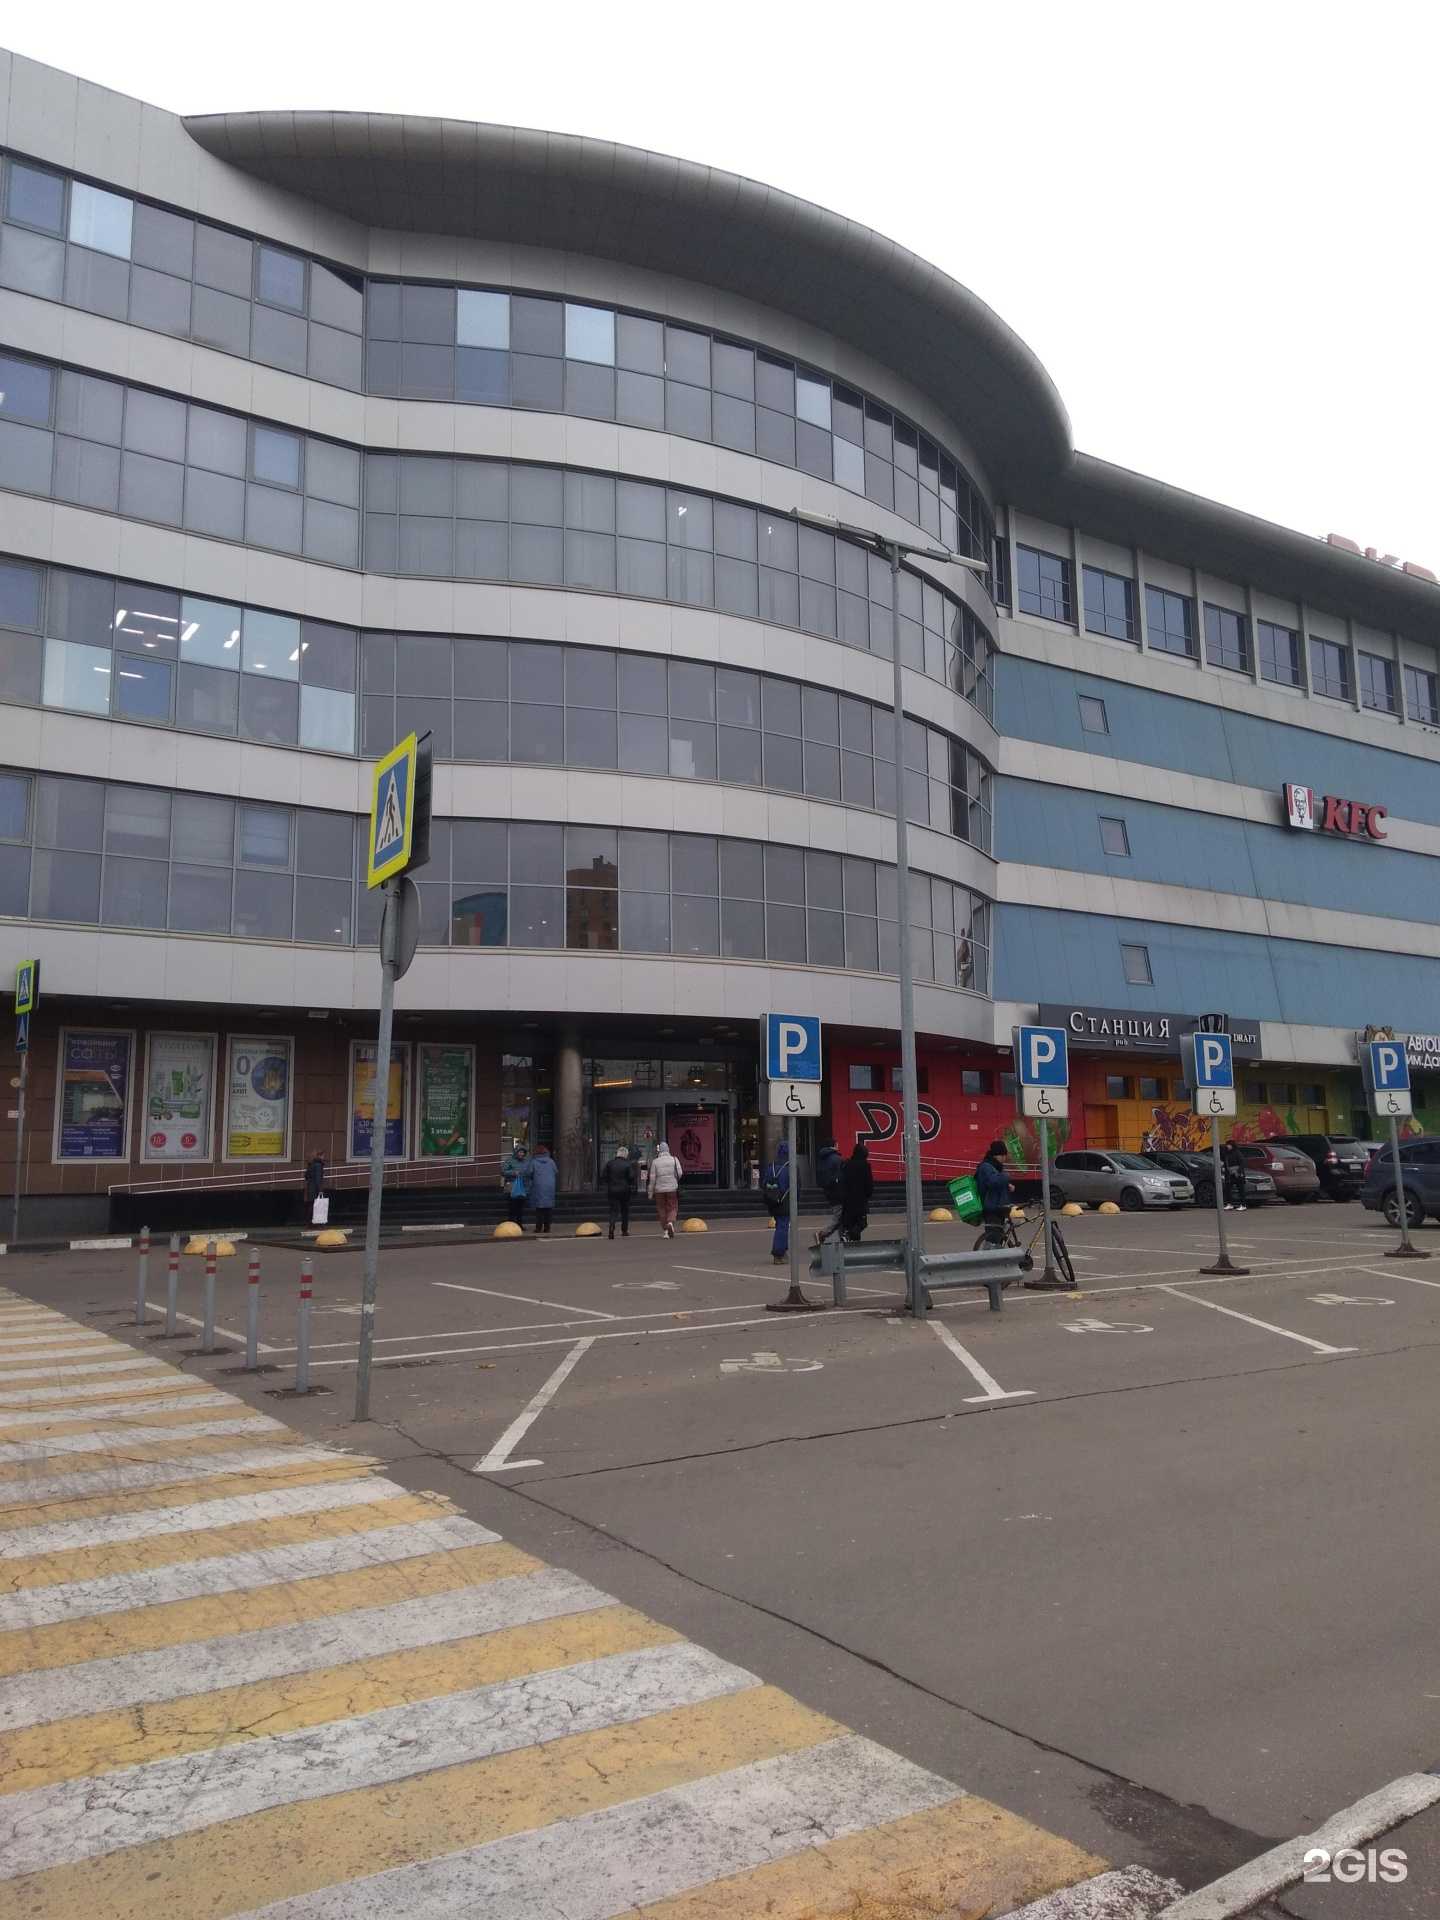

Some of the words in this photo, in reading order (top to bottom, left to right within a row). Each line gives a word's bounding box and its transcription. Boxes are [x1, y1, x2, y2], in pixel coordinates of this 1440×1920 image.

[1323, 796, 1387, 839] KFC
[780, 1022, 807, 1073] P
[1031, 1034, 1056, 1078] P
[1233, 1033, 1257, 1043] DRAFT
[1203, 1040, 1223, 1080] P
[1379, 1047, 1398, 1084] P
